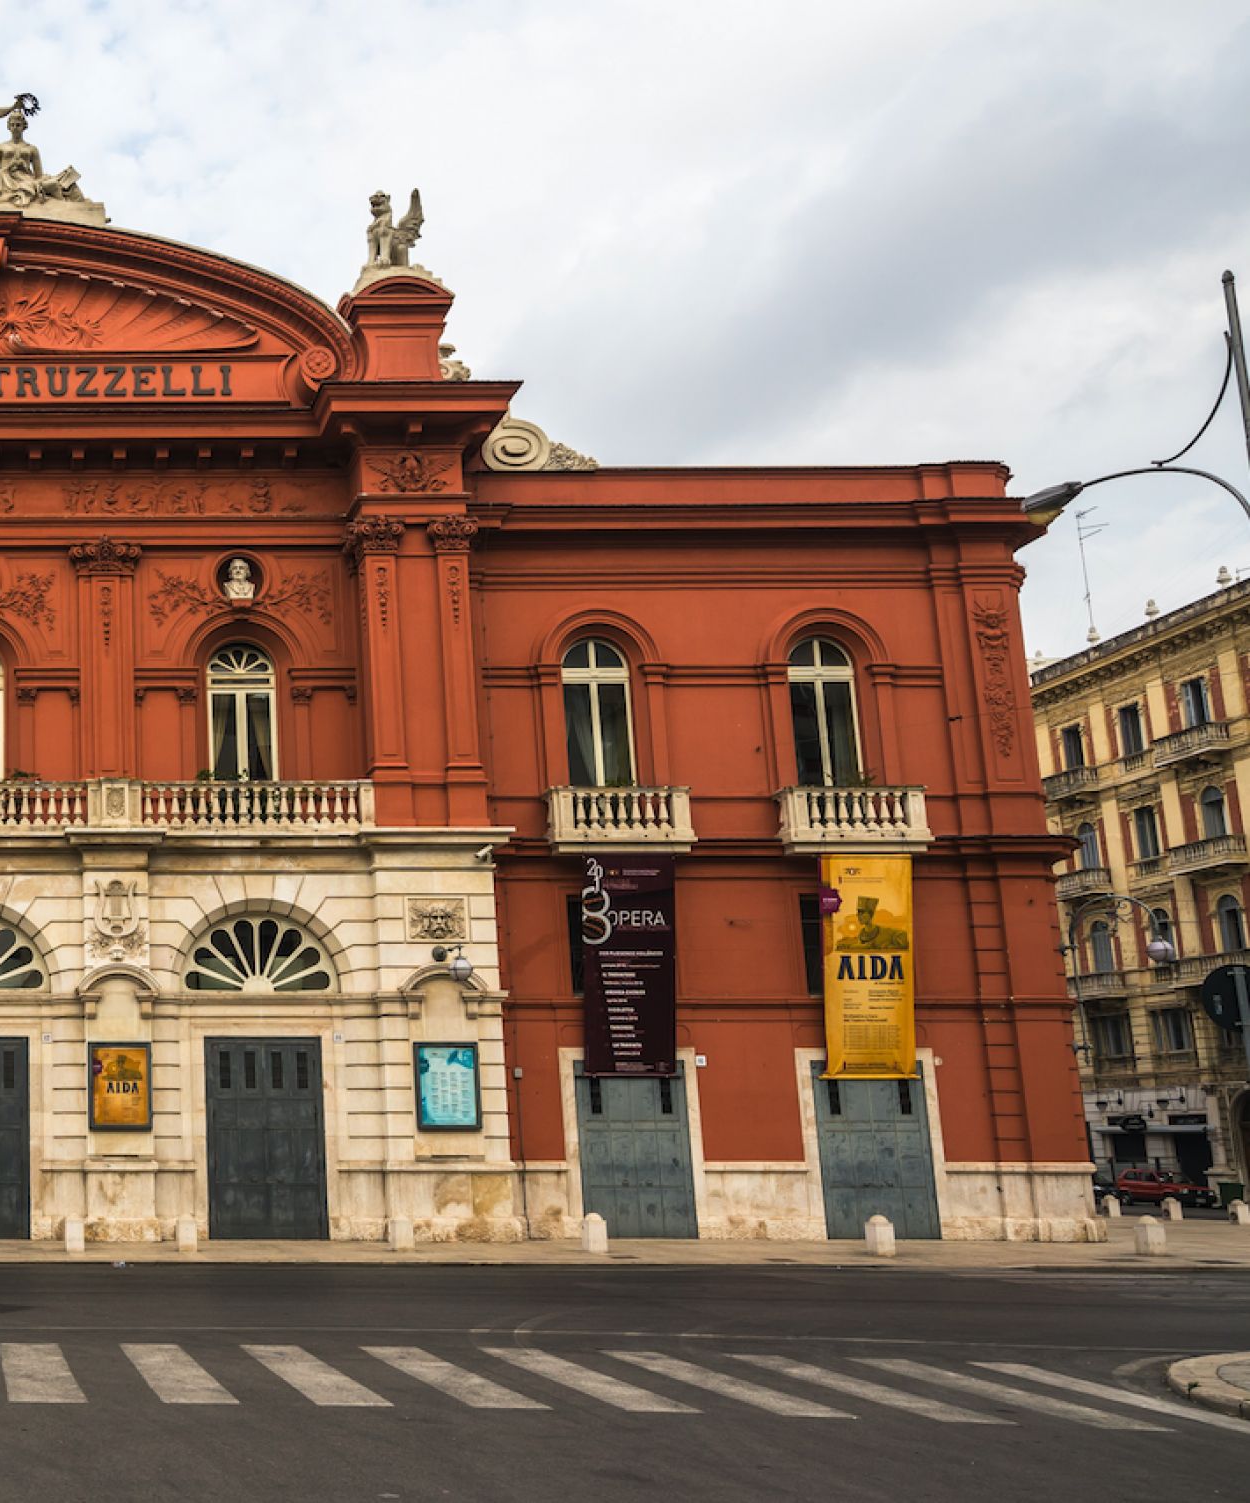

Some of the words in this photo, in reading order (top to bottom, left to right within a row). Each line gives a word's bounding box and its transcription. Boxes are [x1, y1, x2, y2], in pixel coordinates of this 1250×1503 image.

[607, 909, 666, 926] OPERA
[836, 955, 905, 980] AIDA
[107, 1082, 139, 1094] AIDA
